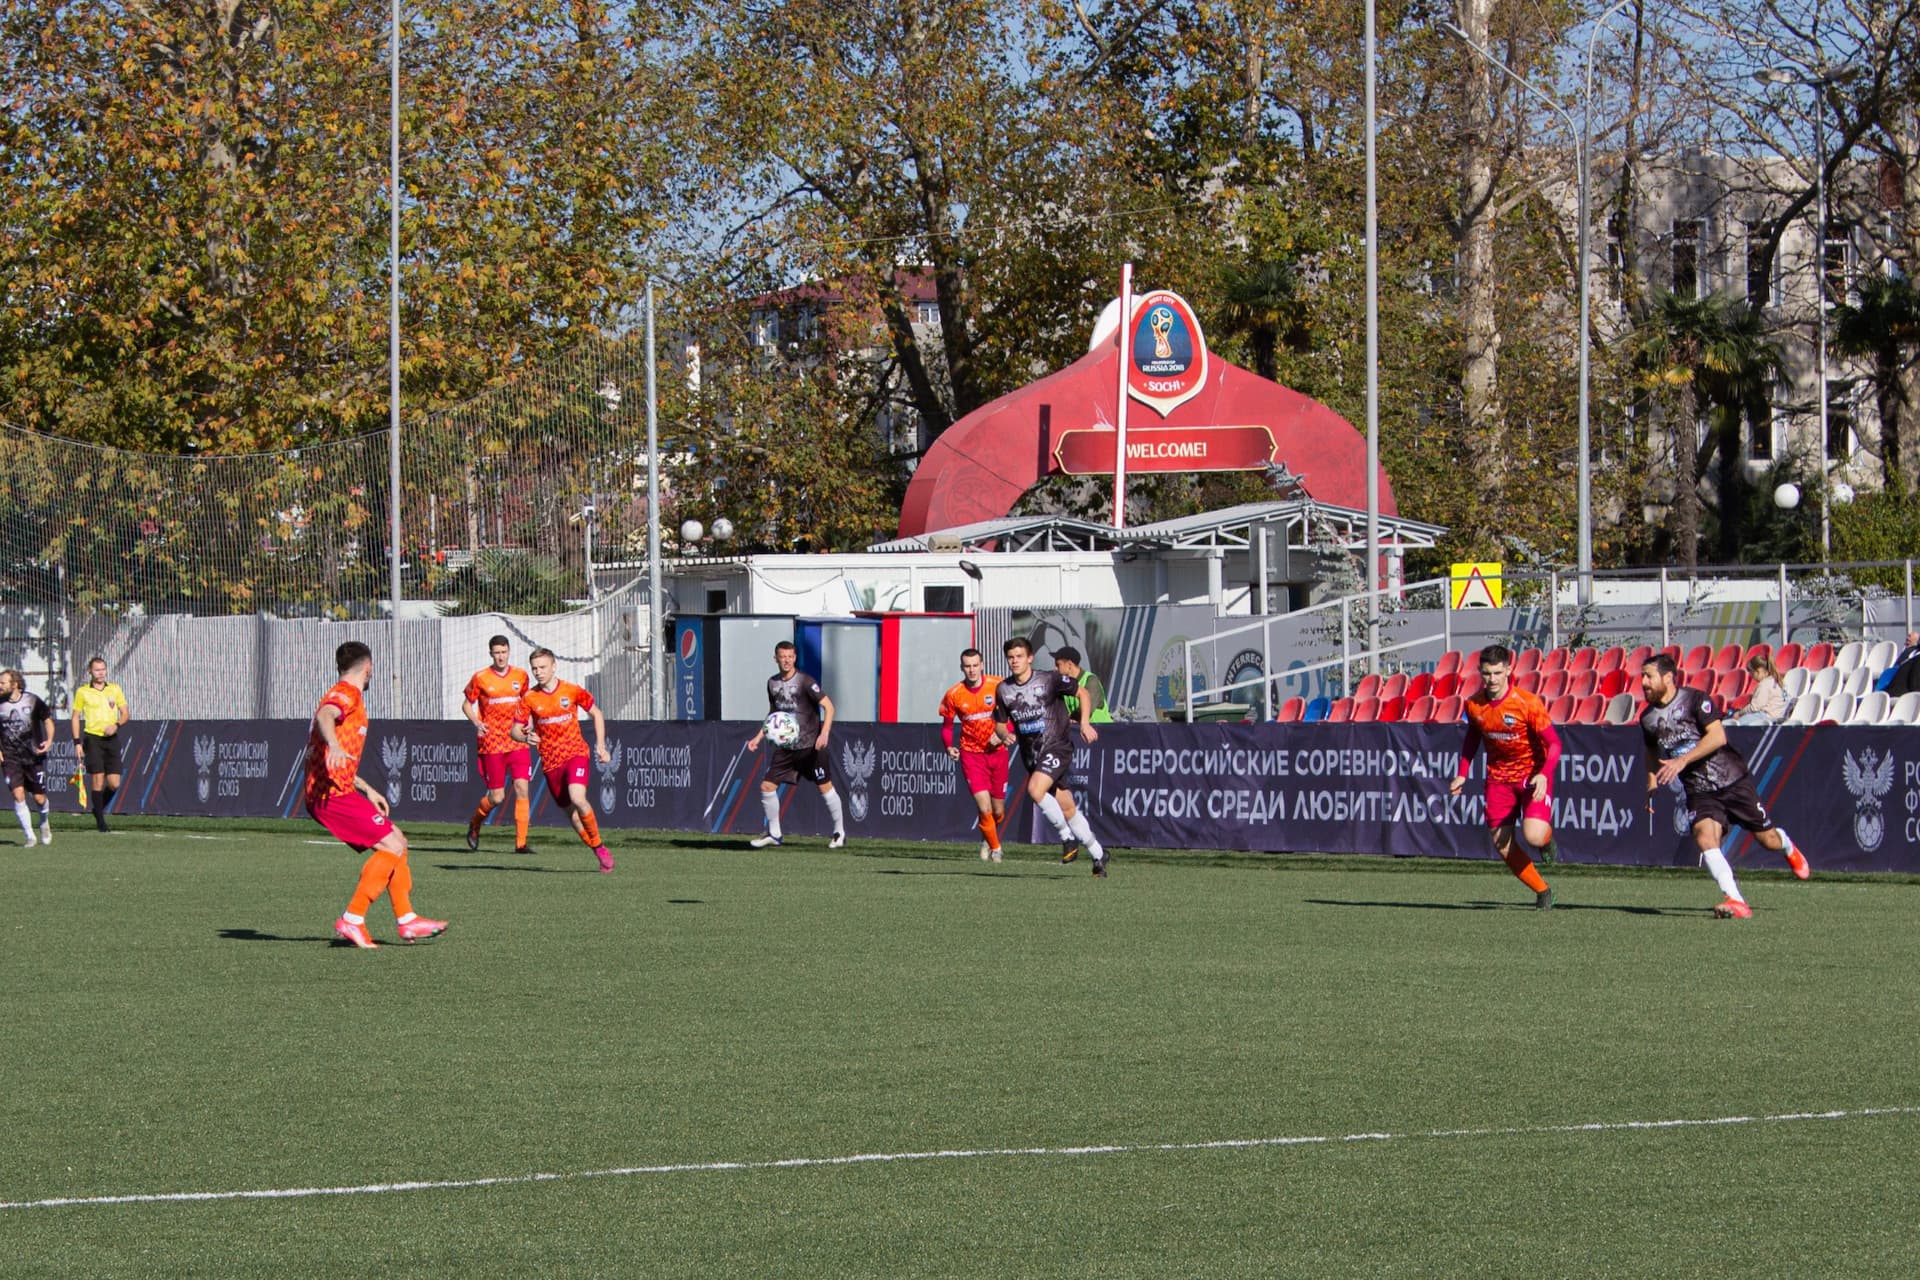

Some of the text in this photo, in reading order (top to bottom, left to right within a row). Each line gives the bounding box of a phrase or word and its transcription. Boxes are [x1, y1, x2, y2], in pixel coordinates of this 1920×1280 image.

[1142, 364, 1185, 372] RUSSIA 2018
[1148, 380, 1180, 392] SOCHI
[1126, 442, 1207, 459] WELCOME!
[217, 739, 269, 761] РОССИЙСКИЙ
[410, 741, 469, 763] РОССИЙСКИЙ
[626, 742, 691, 767] РОССИЙСКИЙ
[1113, 743, 1289, 776] ВСЕРОССИЙСКИЕ
[217, 759, 269, 779] ФУТБОЛЬНЫЙ
[1042, 752, 1061, 769] 29
[47, 775, 67, 792] СОЮЗ
[410, 762, 469, 785] ФУТБОЛЬНЫЙ
[626, 765, 691, 790] ФУТБОЛЬНЫЙ
[814, 766, 826, 781] 14
[217, 778, 240, 798] СОЮЗ
[410, 783, 437, 802] СОЮЗ
[880, 771, 957, 797] ФУТБОЛЬНЫЙ
[626, 789, 655, 808] СОЮЗ
[880, 795, 914, 817] СОЮЗ
[1111, 787, 1201, 820] «КУБОК
[1207, 789, 1286, 825] СРЕДИ
